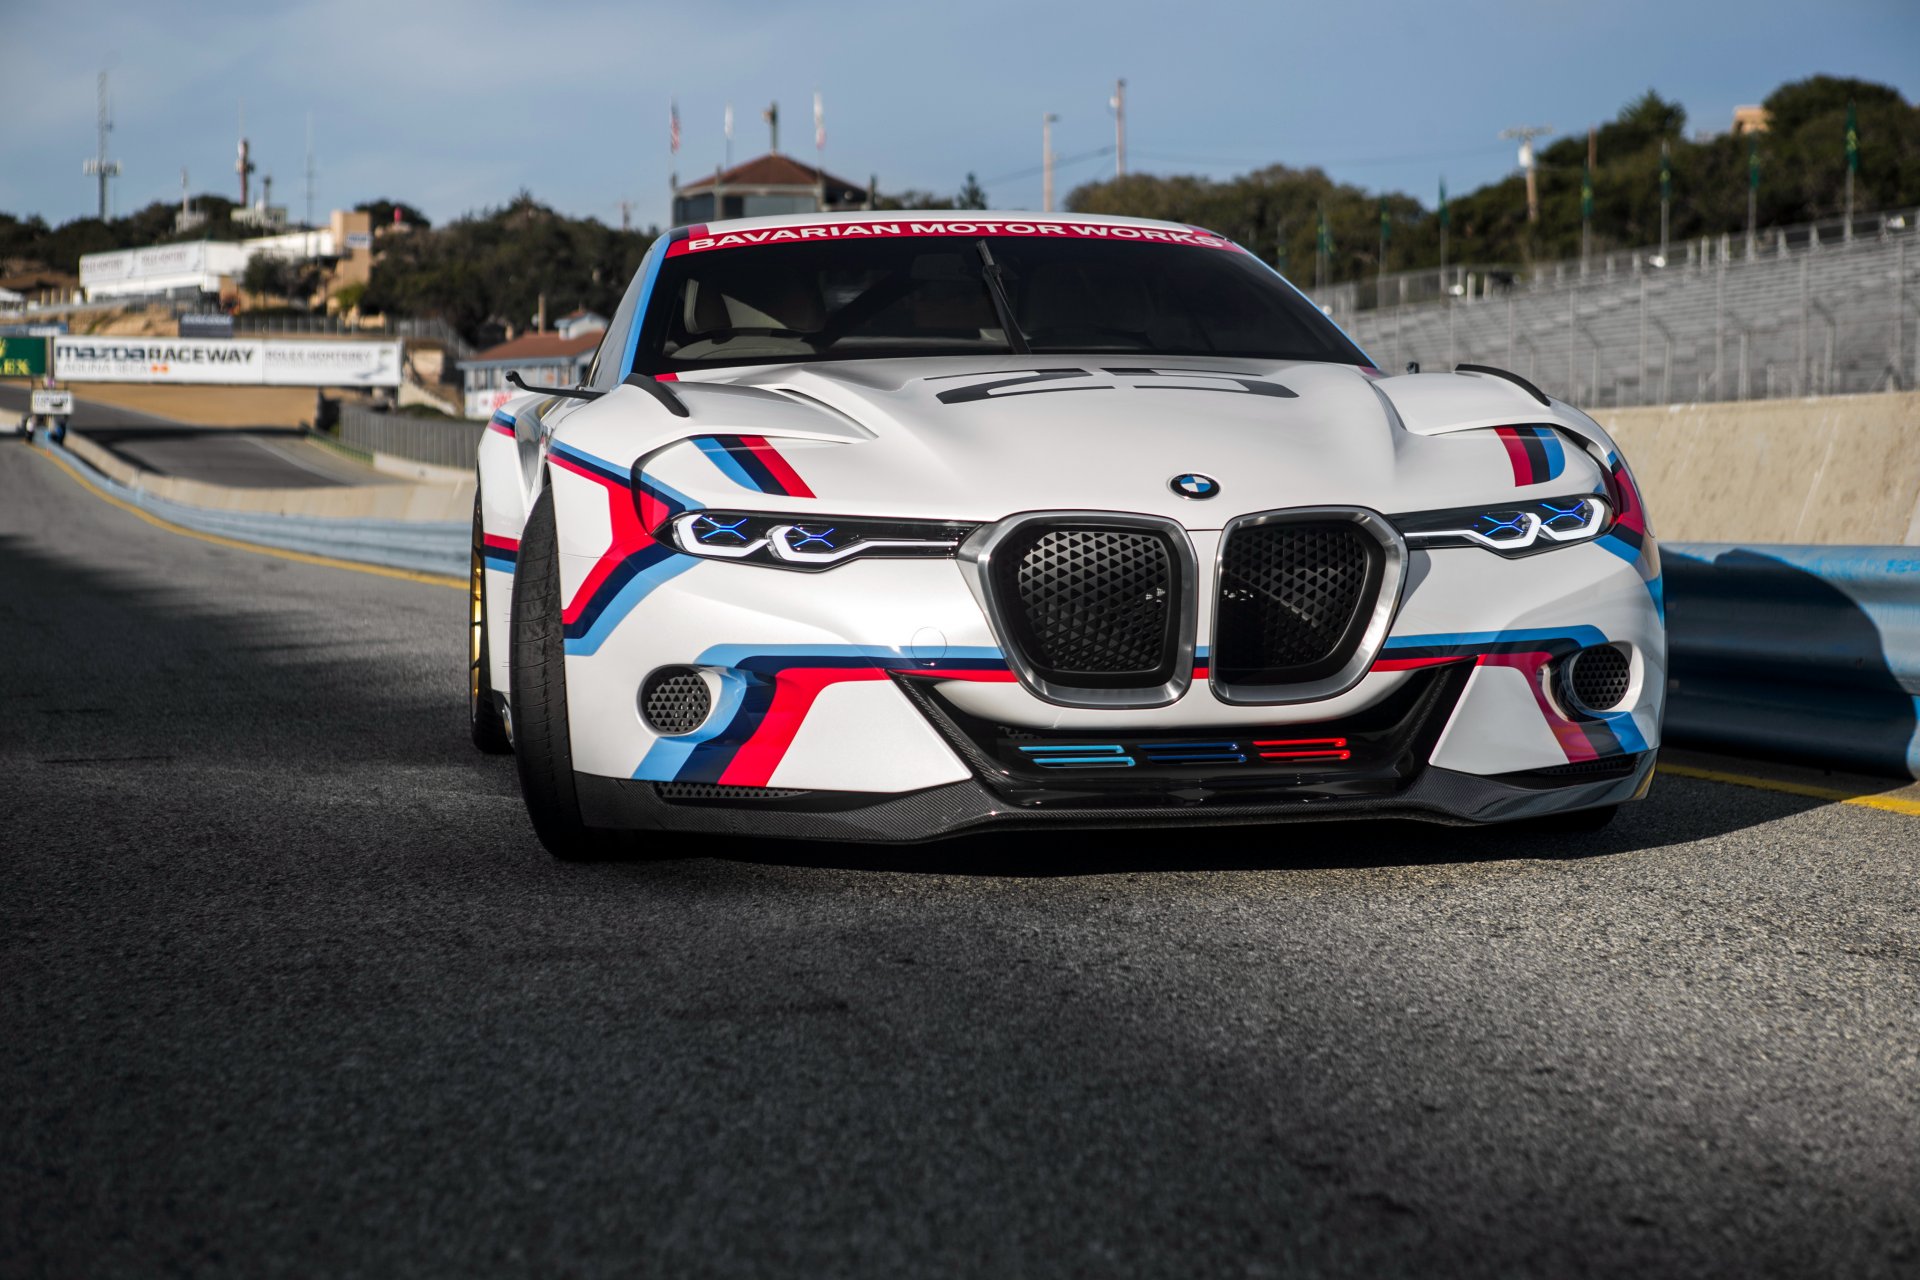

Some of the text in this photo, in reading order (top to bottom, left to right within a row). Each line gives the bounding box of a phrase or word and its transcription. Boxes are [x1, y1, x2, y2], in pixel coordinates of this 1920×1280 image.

[688, 223, 1224, 251] BAVARIAN MOTOR WORKS
[149, 347, 252, 363] RACEWAY
